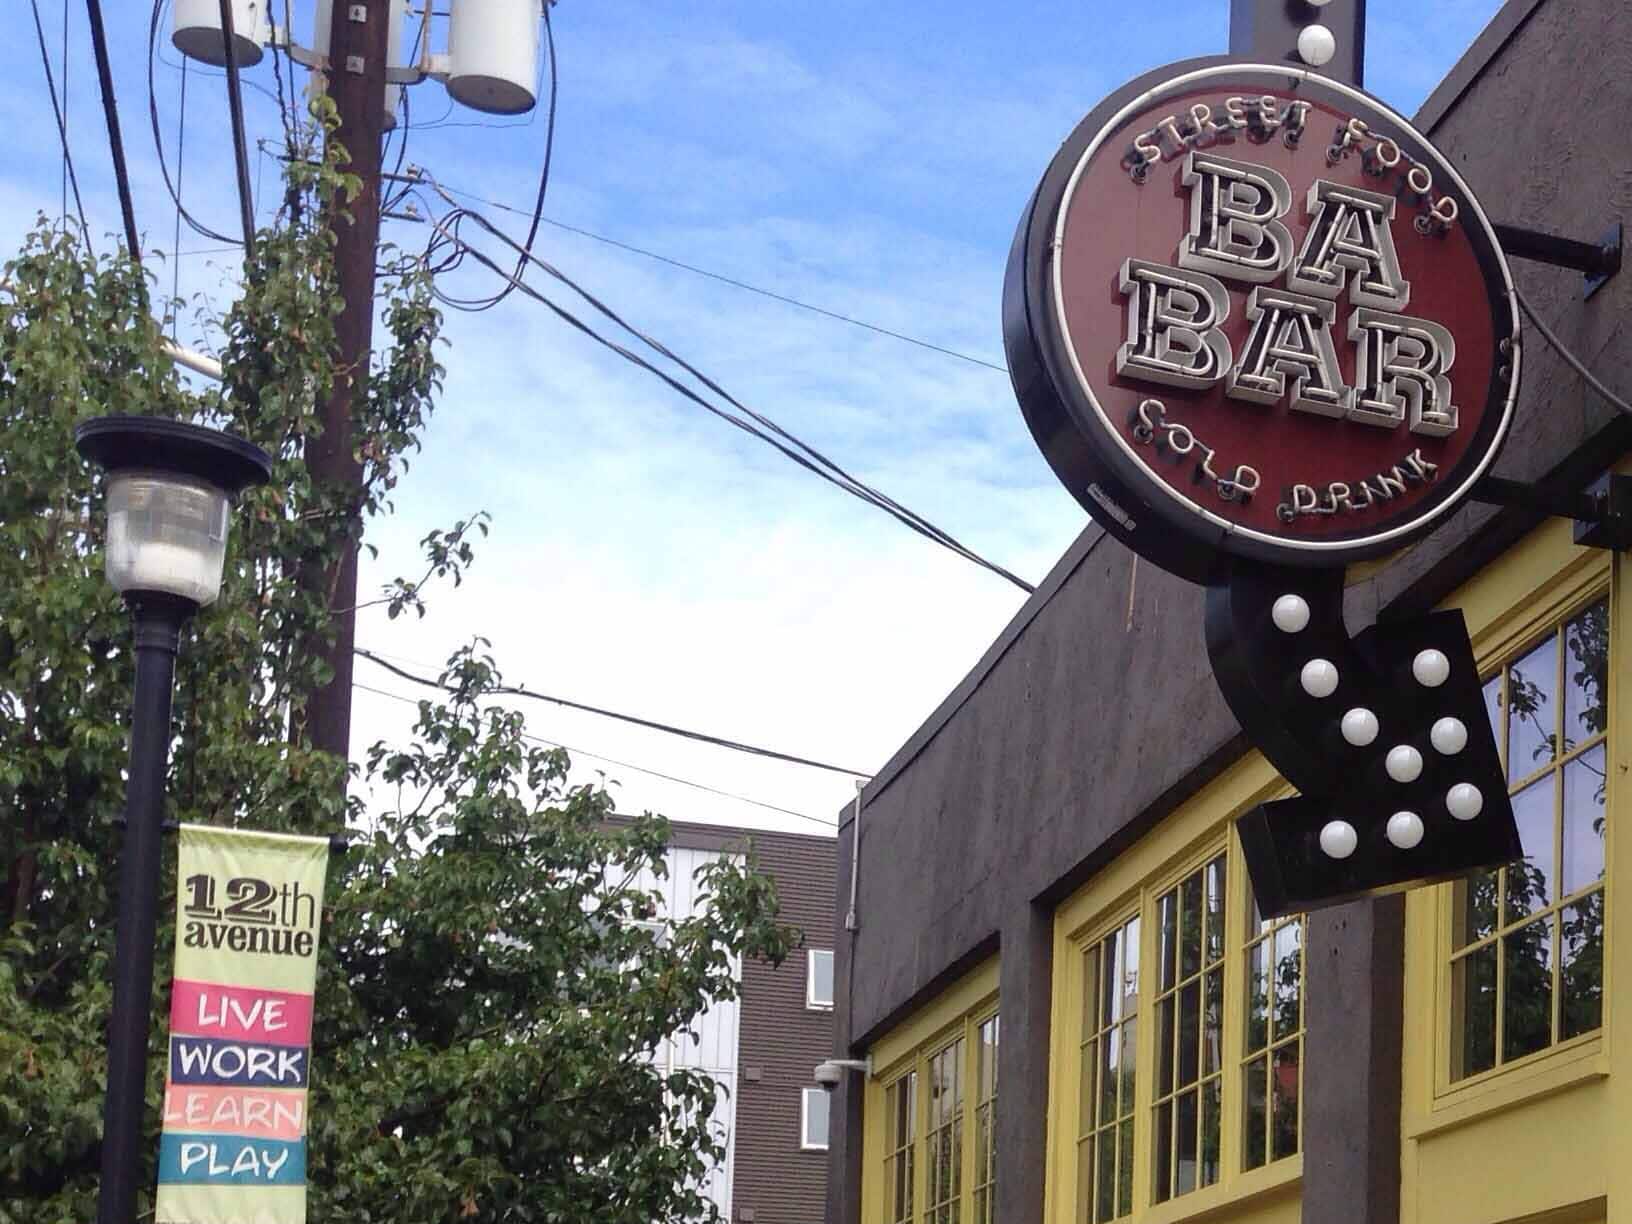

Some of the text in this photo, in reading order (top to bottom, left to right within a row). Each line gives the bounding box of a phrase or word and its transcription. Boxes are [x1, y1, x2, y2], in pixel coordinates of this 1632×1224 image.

[1132, 96, 1459, 224] STREET FOOD
[1178, 151, 1411, 312] BA
[1117, 257, 1459, 437] BAR
[1139, 399, 1438, 512] COLD DRINK
[183, 873, 316, 929] 12th
[183, 919, 314, 958] avenue
[198, 993, 289, 1032] LIVE
[178, 1043, 303, 1084] WORK
[162, 1089, 302, 1131] LEARN
[179, 1142, 289, 1180] PLAY
